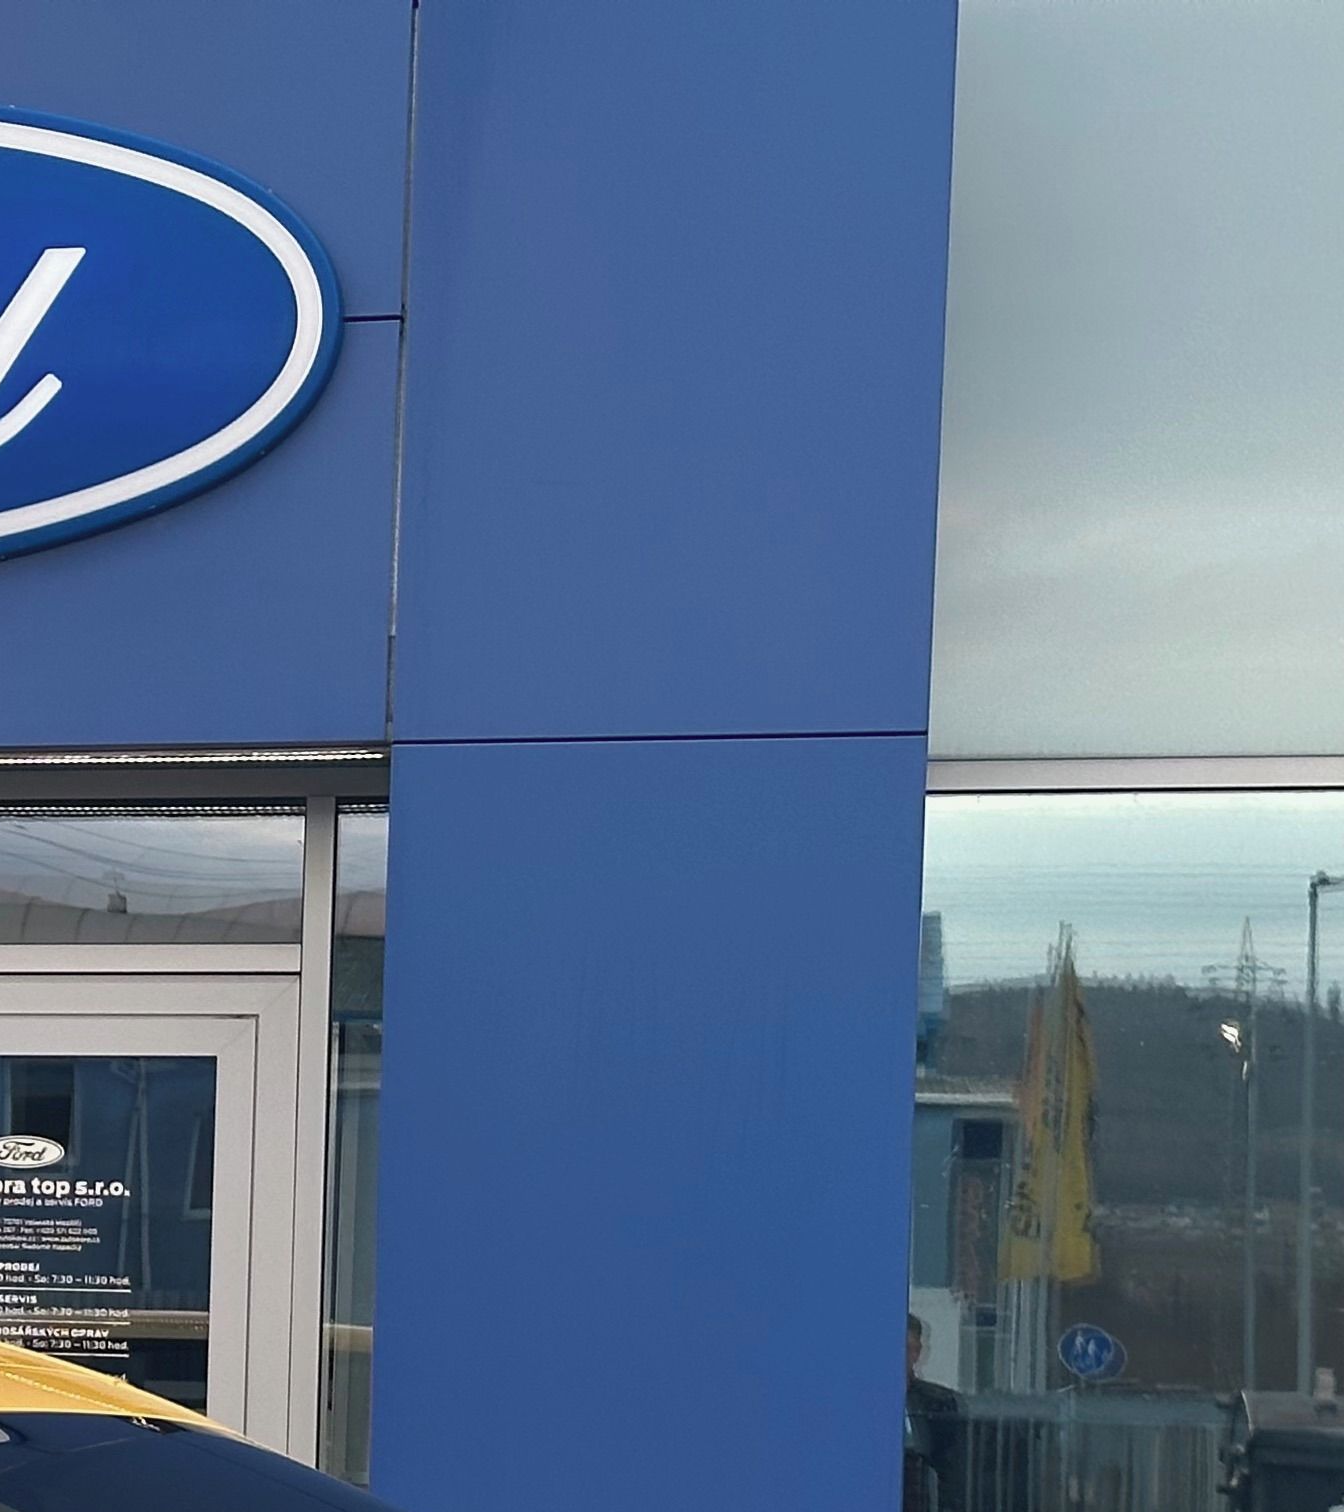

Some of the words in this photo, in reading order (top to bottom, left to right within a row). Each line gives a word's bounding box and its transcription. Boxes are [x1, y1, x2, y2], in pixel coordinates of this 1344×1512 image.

[31, 1178, 70, 1198] top
[74, 1180, 131, 1198] s.r.o.
[35, 1199, 43, 1207] a
[74, 1198, 103, 1208] FORD
[51, 1274, 73, 1284] 7:30
[85, 1275, 108, 1285] 11:30
